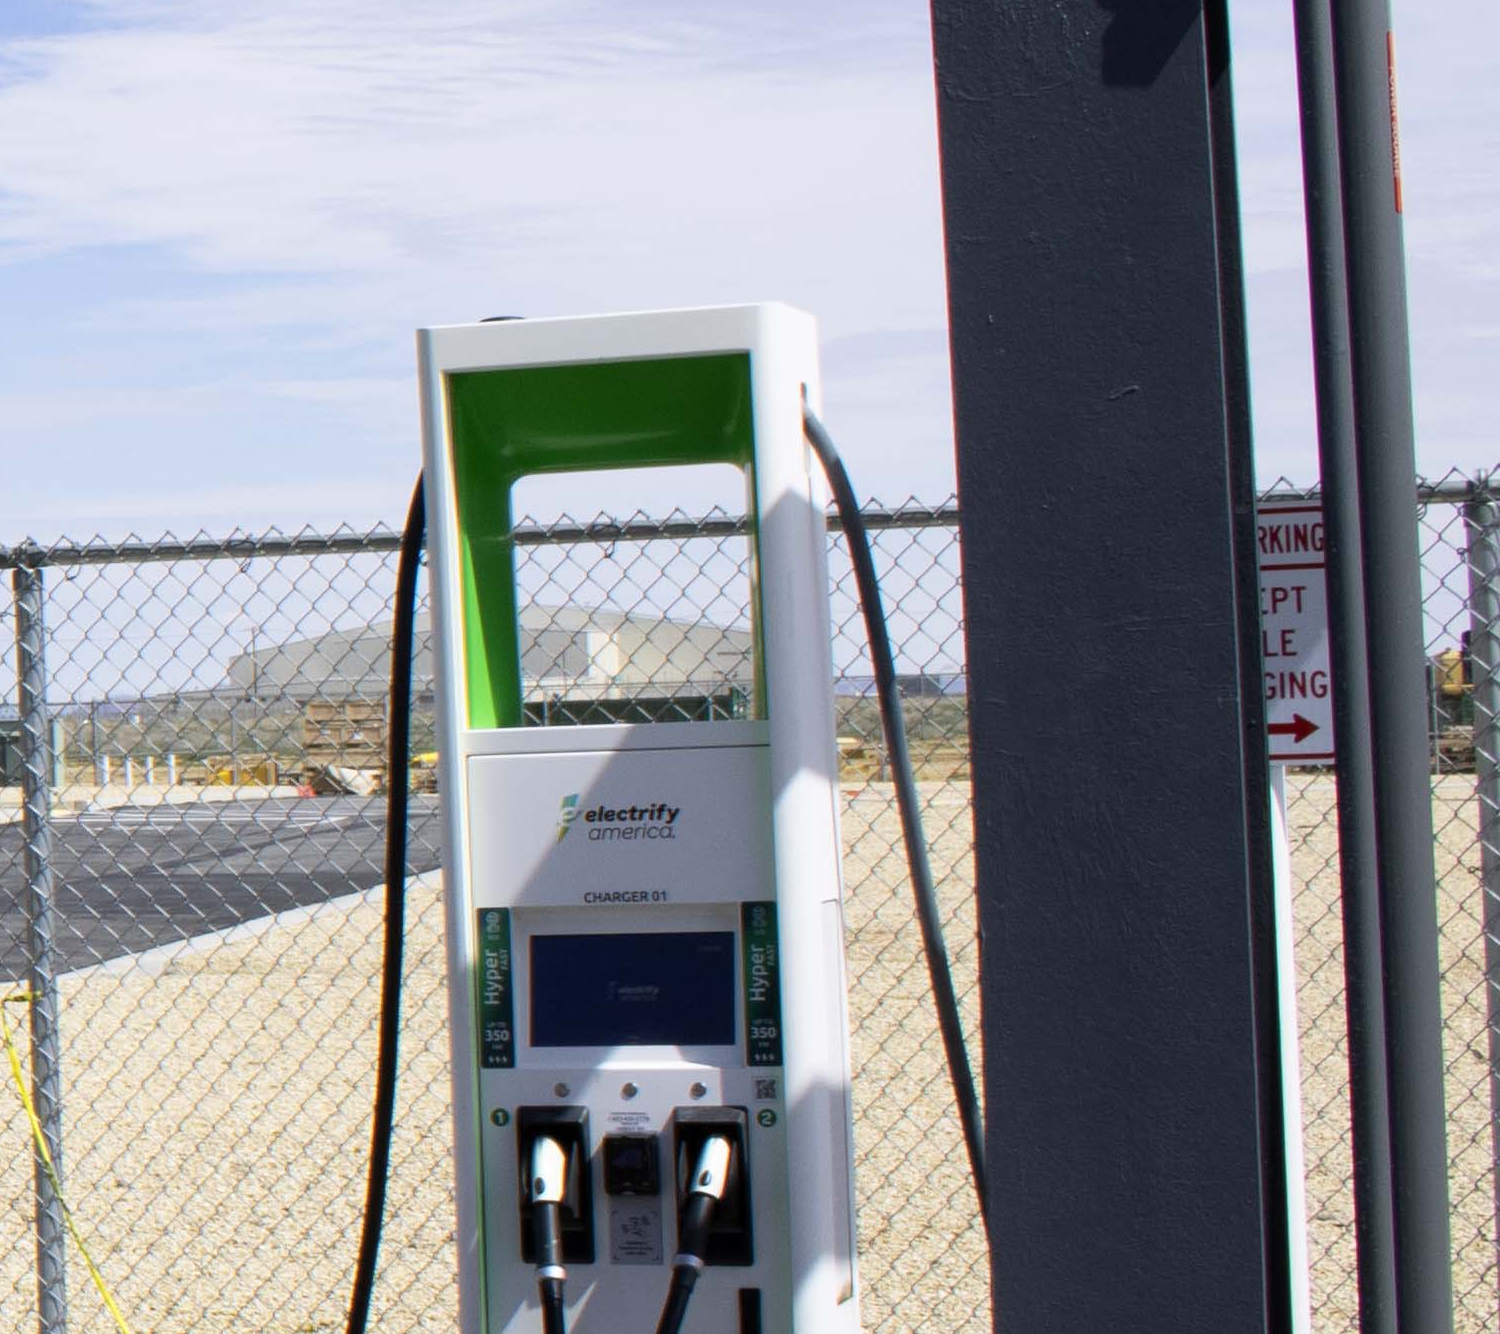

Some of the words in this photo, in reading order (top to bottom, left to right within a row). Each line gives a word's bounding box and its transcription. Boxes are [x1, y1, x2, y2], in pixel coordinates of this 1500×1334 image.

[1258, 523, 1324, 554] RKING
[1264, 671, 1328, 700] GING
[584, 803, 680, 824] electrify
[583, 891, 649, 903] CHARGER
[651, 891, 668, 902] 01
[484, 949, 503, 1005] Hyper
[750, 944, 769, 1002] Hyper
[485, 1029, 509, 1042] 350
[750, 1026, 777, 1039] 350
